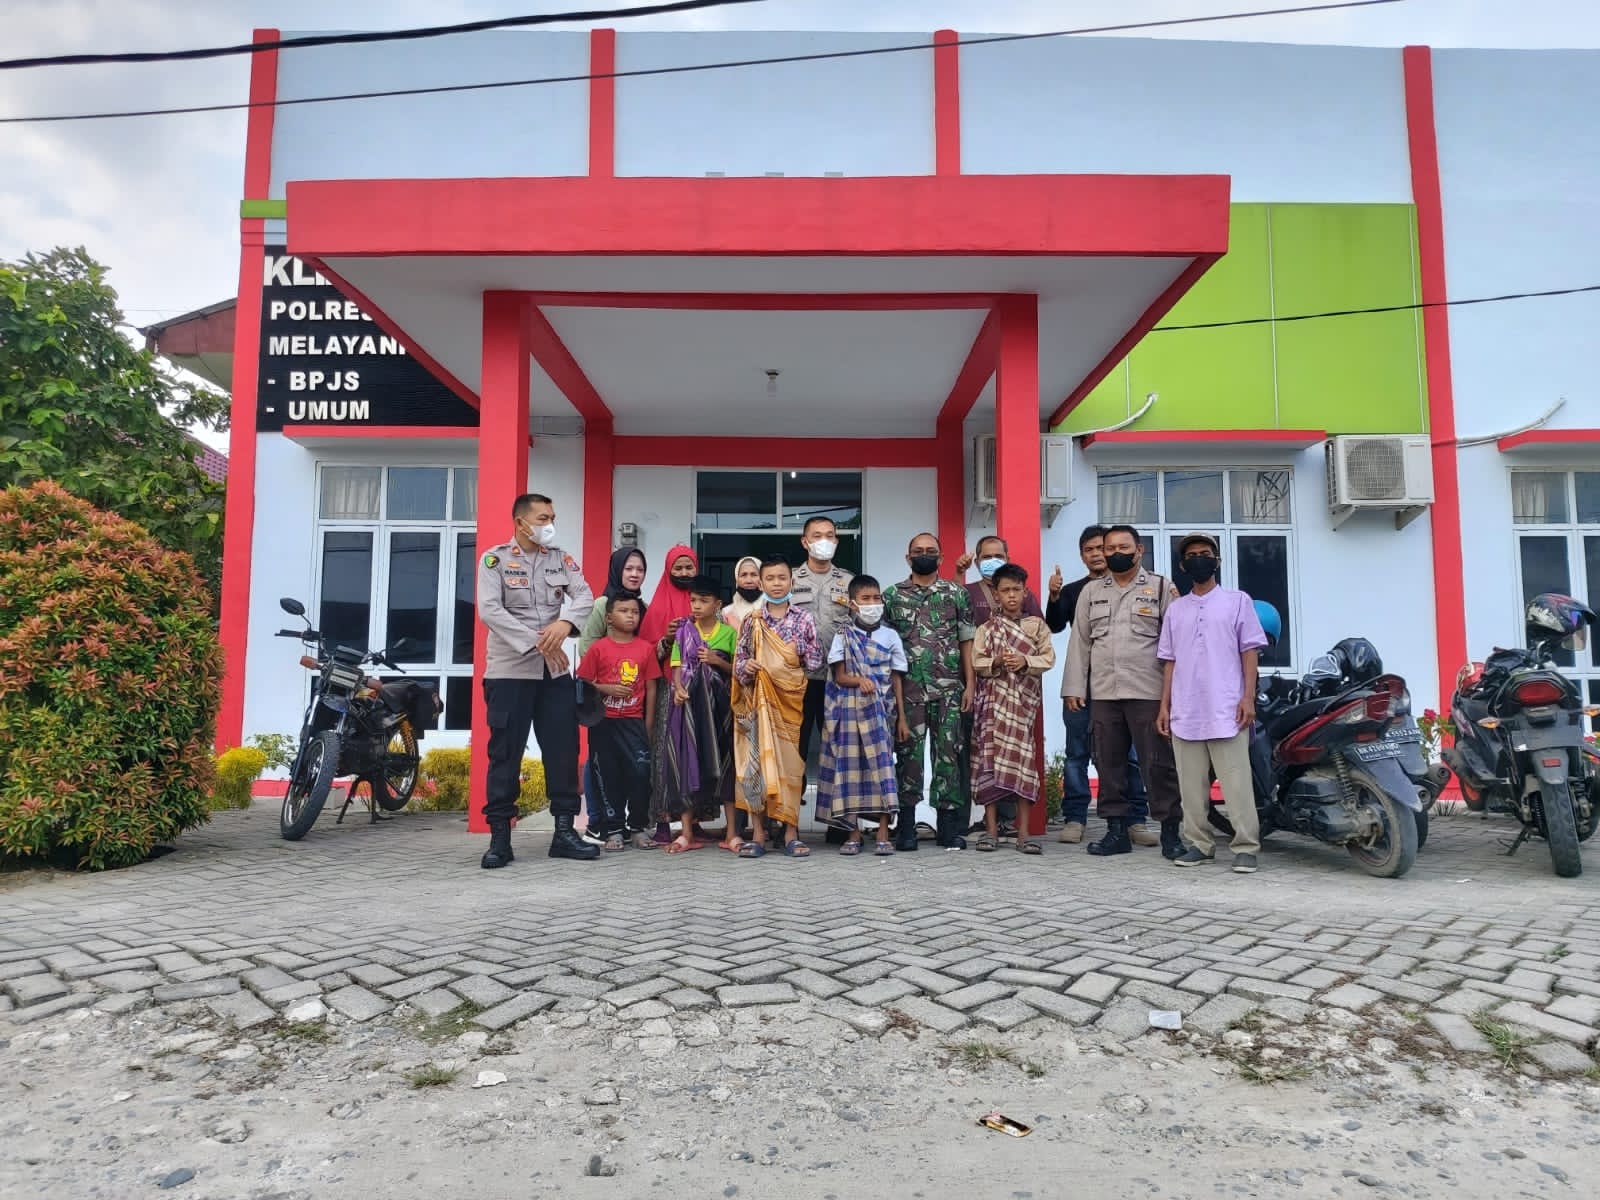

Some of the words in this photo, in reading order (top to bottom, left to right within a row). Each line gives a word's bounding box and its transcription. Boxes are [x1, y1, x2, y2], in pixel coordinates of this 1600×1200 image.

[264, 255, 333, 286] KL
[289, 371, 360, 391] BPJS
[288, 400, 370, 420] UMUM
